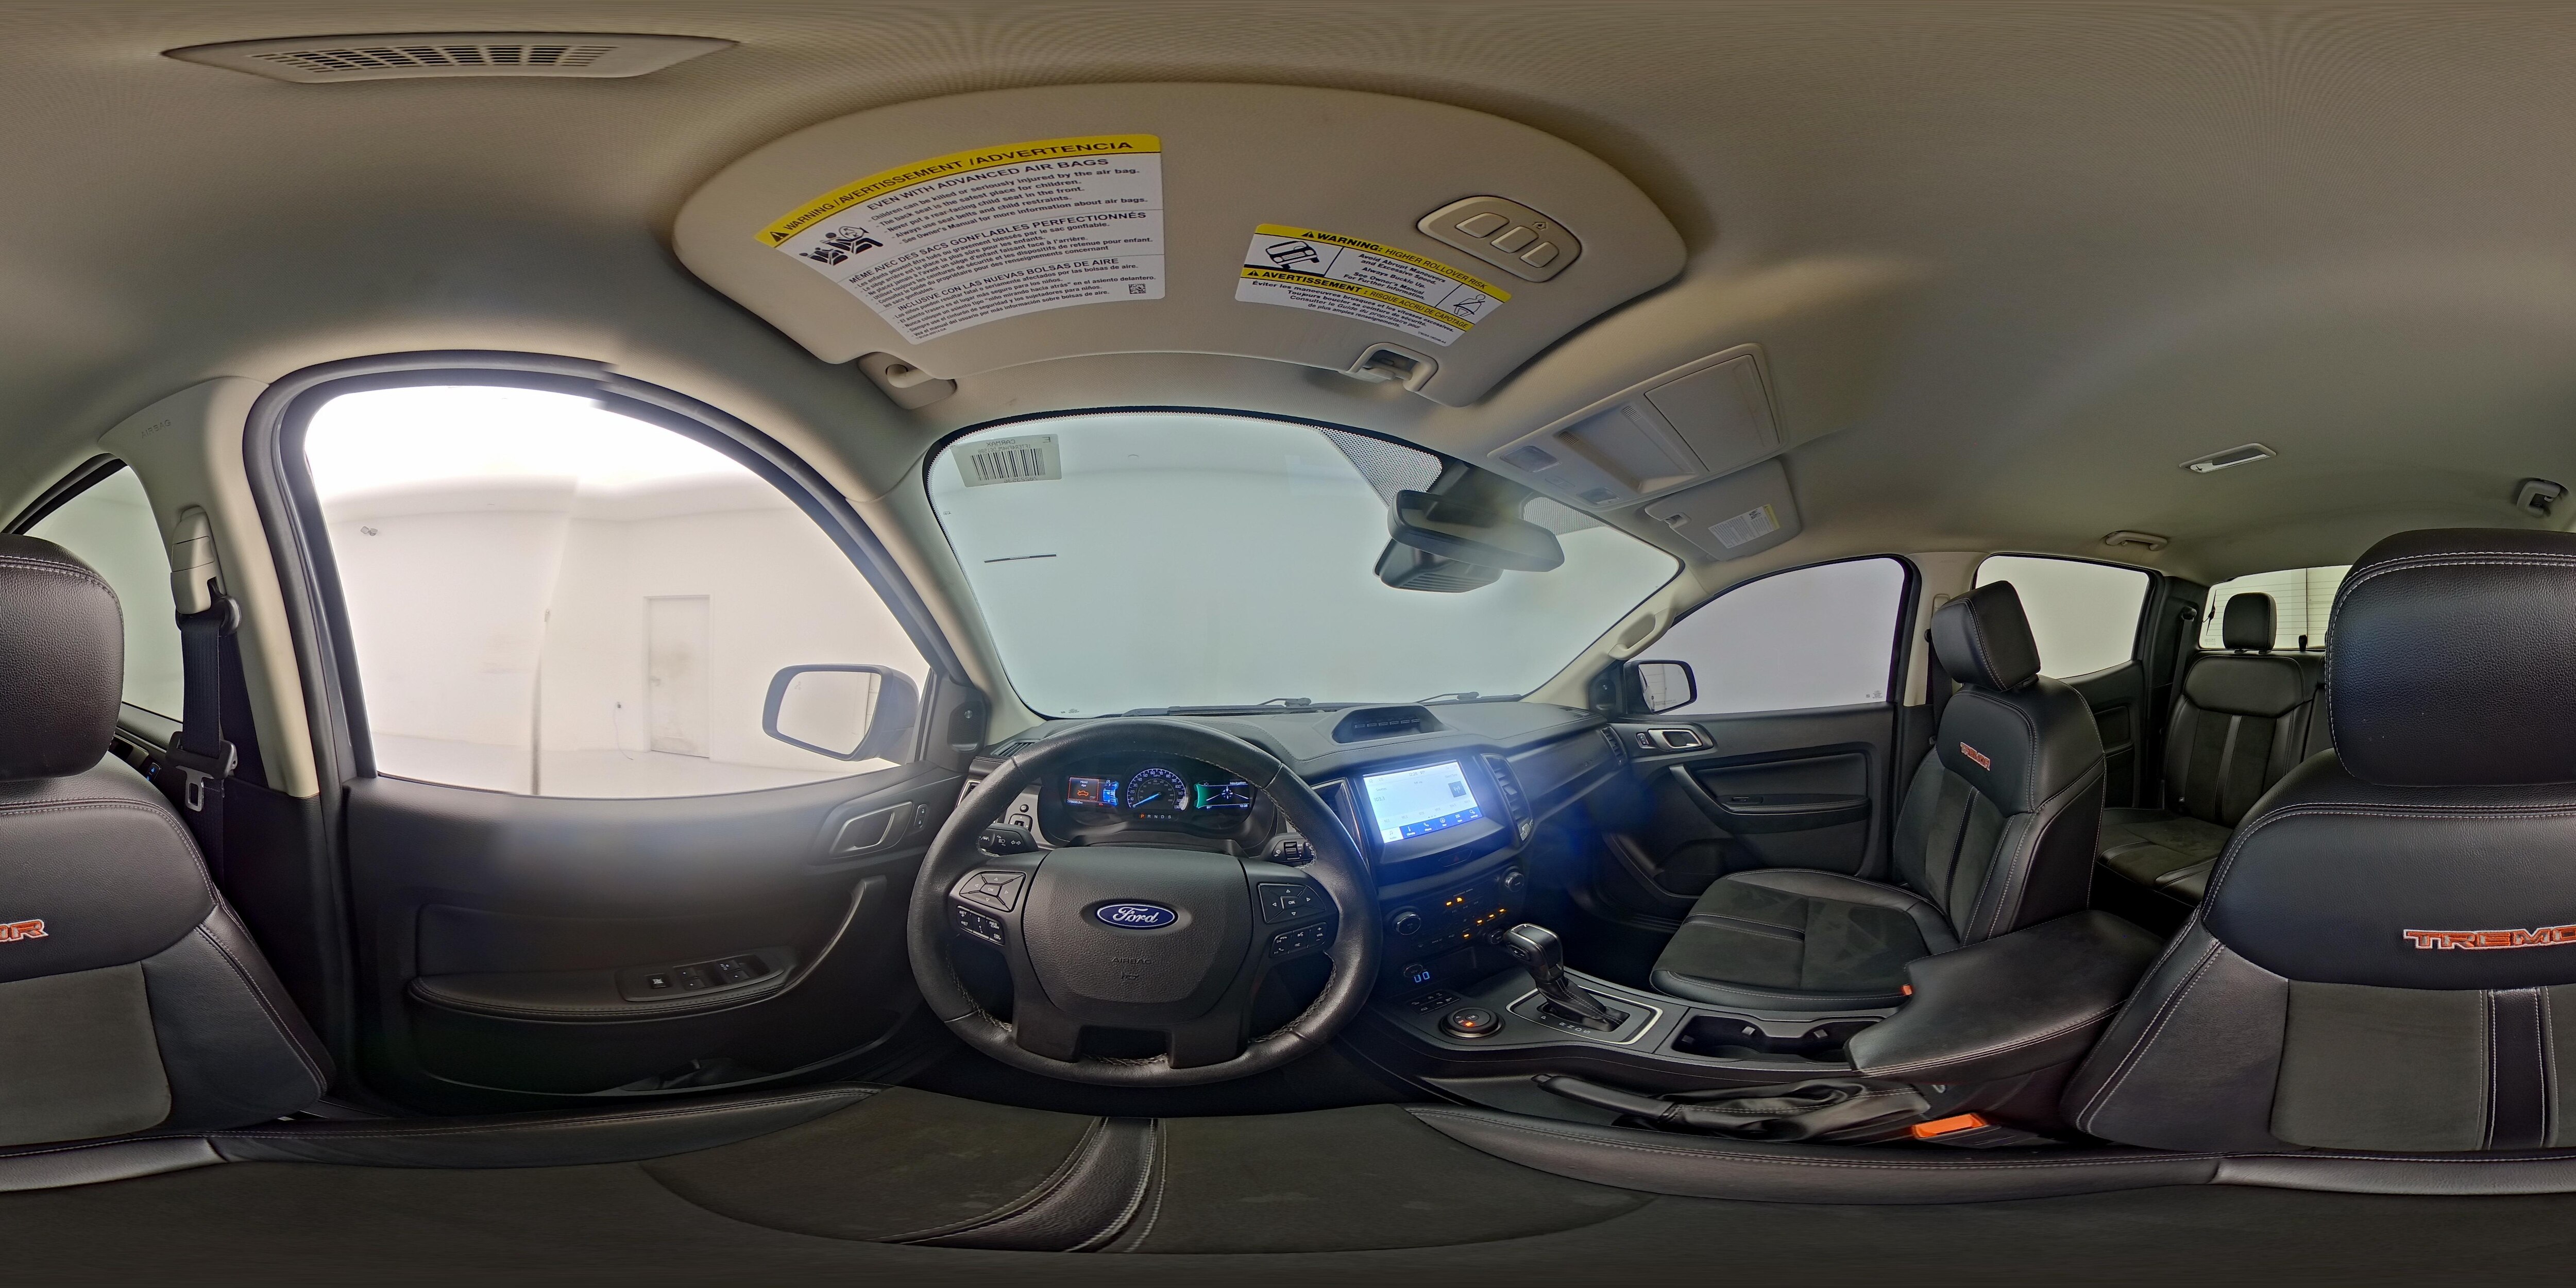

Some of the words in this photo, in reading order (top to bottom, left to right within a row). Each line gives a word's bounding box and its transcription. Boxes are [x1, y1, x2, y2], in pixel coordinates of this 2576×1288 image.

[866, 195, 900, 210] EVEN
[899, 185, 935, 198] WITH
[937, 168, 1020, 189] ADVANCED
[1025, 163, 1054, 172] AIR
[1057, 159, 1109, 168] BAGS
[871, 208, 903, 221] Children
[930, 191, 957, 201] killed
[970, 180, 1014, 192] seriously
[1016, 174, 1055, 183] injured
[783, 203, 836, 230] WARNING
[916, 227, 947, 238] Owner's
[946, 218, 978, 229] Manual
[848, 269, 874, 283] MÊME
[874, 260, 898, 273] AVEC
[897, 252, 919, 262] DES
[919, 242, 948, 255] SACS
[950, 224, 1030, 245] GONFLABLES
[1031, 211, 1146, 228] PERFECTIONNÉS
[1317, 232, 1383, 252] WARNING:
[1384, 248, 1422, 263] HIGHER
[1422, 260, 1469, 281] ROLLOVER
[1467, 278, 1487, 289] RISK
[1358, 253, 1381, 262] Avoid
[1381, 259, 1408, 269] Abrupt
[1409, 267, 1446, 282] Maneuvers
[1361, 266, 1388, 276] Always
[1389, 274, 1414, 284] Buckle
[1377, 263, 1413, 276] Excessive
[1414, 274, 1436, 284] Speed.
[897, 292, 941, 311] INCLUSIVE
[941, 285, 962, 295] CON
[962, 280, 982, 289] LAS
[982, 270, 1024, 283] NUEVAS
[1026, 263, 1071, 275] BOLSAS
[1357, 277, 1385, 287] Further
[1369, 275, 1398, 286] Owner's
[1399, 284, 1425, 295] Manual
[1261, 271, 1363, 292] AVERTISSEMENT
[1369, 291, 1399, 302] RISQUE
[1398, 299, 1425, 311] ACCRU
[1434, 312, 1468, 328] CAPOTAGE
[1287, 289, 1321, 298] Toujours
[1322, 295, 1351, 304] boucler
[1362, 304, 1390, 314] ceinture
[1400, 315, 1426, 326] sécurité.
[1290, 295, 1327, 304] Consulter
[1342, 294, 1376, 306] brusques
[1397, 309, 1422, 319] vitesses
[1960, 741, 1990, 771] TREMOR
[1113, 907, 1159, 923] Ford
